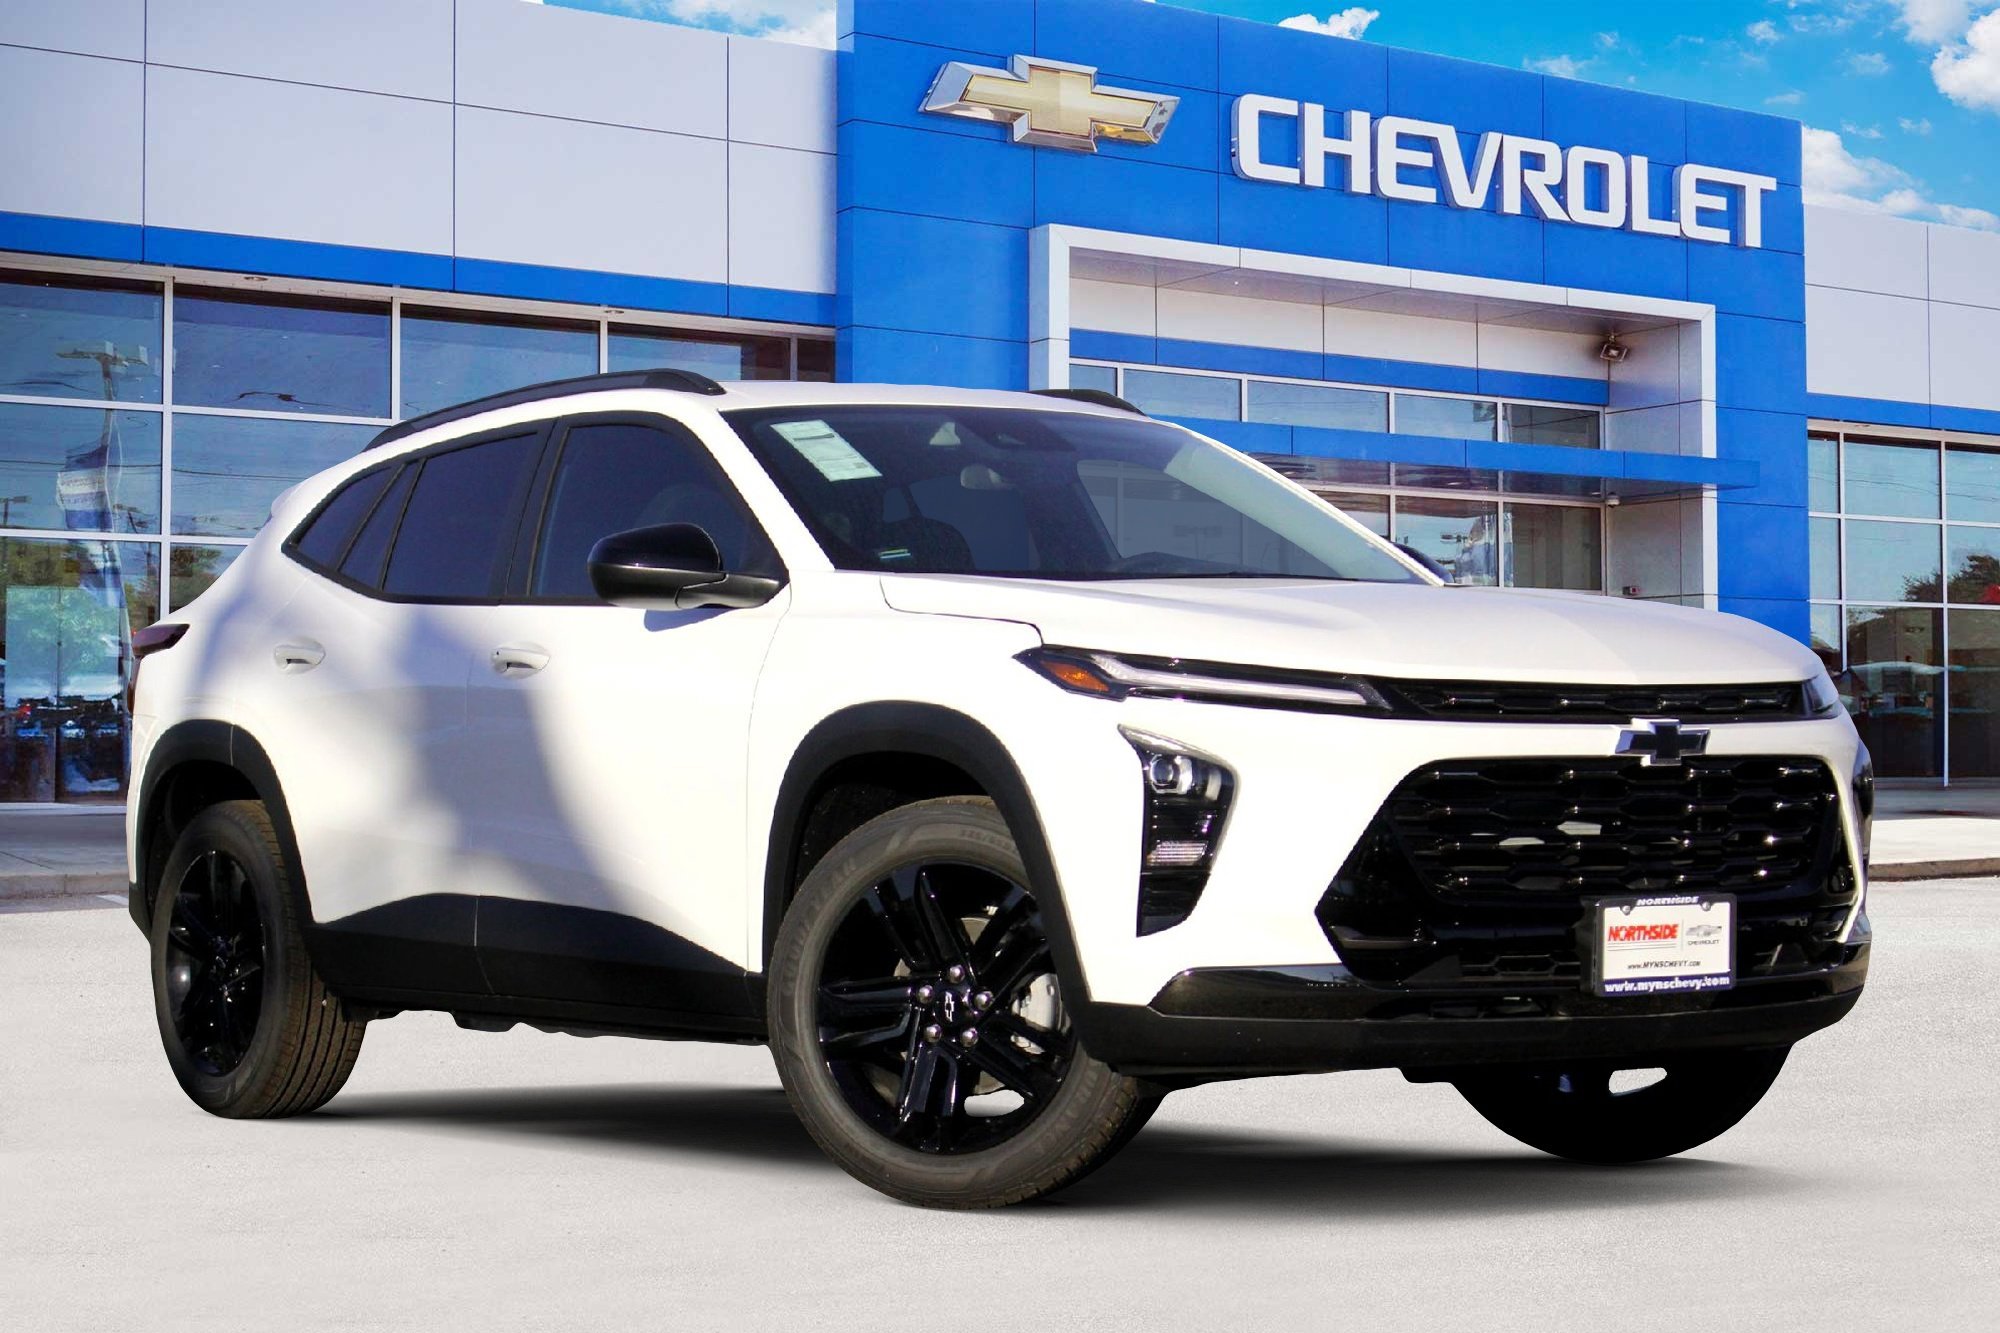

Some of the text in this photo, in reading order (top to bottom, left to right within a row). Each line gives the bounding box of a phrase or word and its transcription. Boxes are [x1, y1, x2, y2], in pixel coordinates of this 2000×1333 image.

[1231, 93, 1778, 249] CHEVROLET
[1607, 924, 1679, 942] NORTHSIDE
[1604, 976, 1730, 993] www.mynschevy.com
